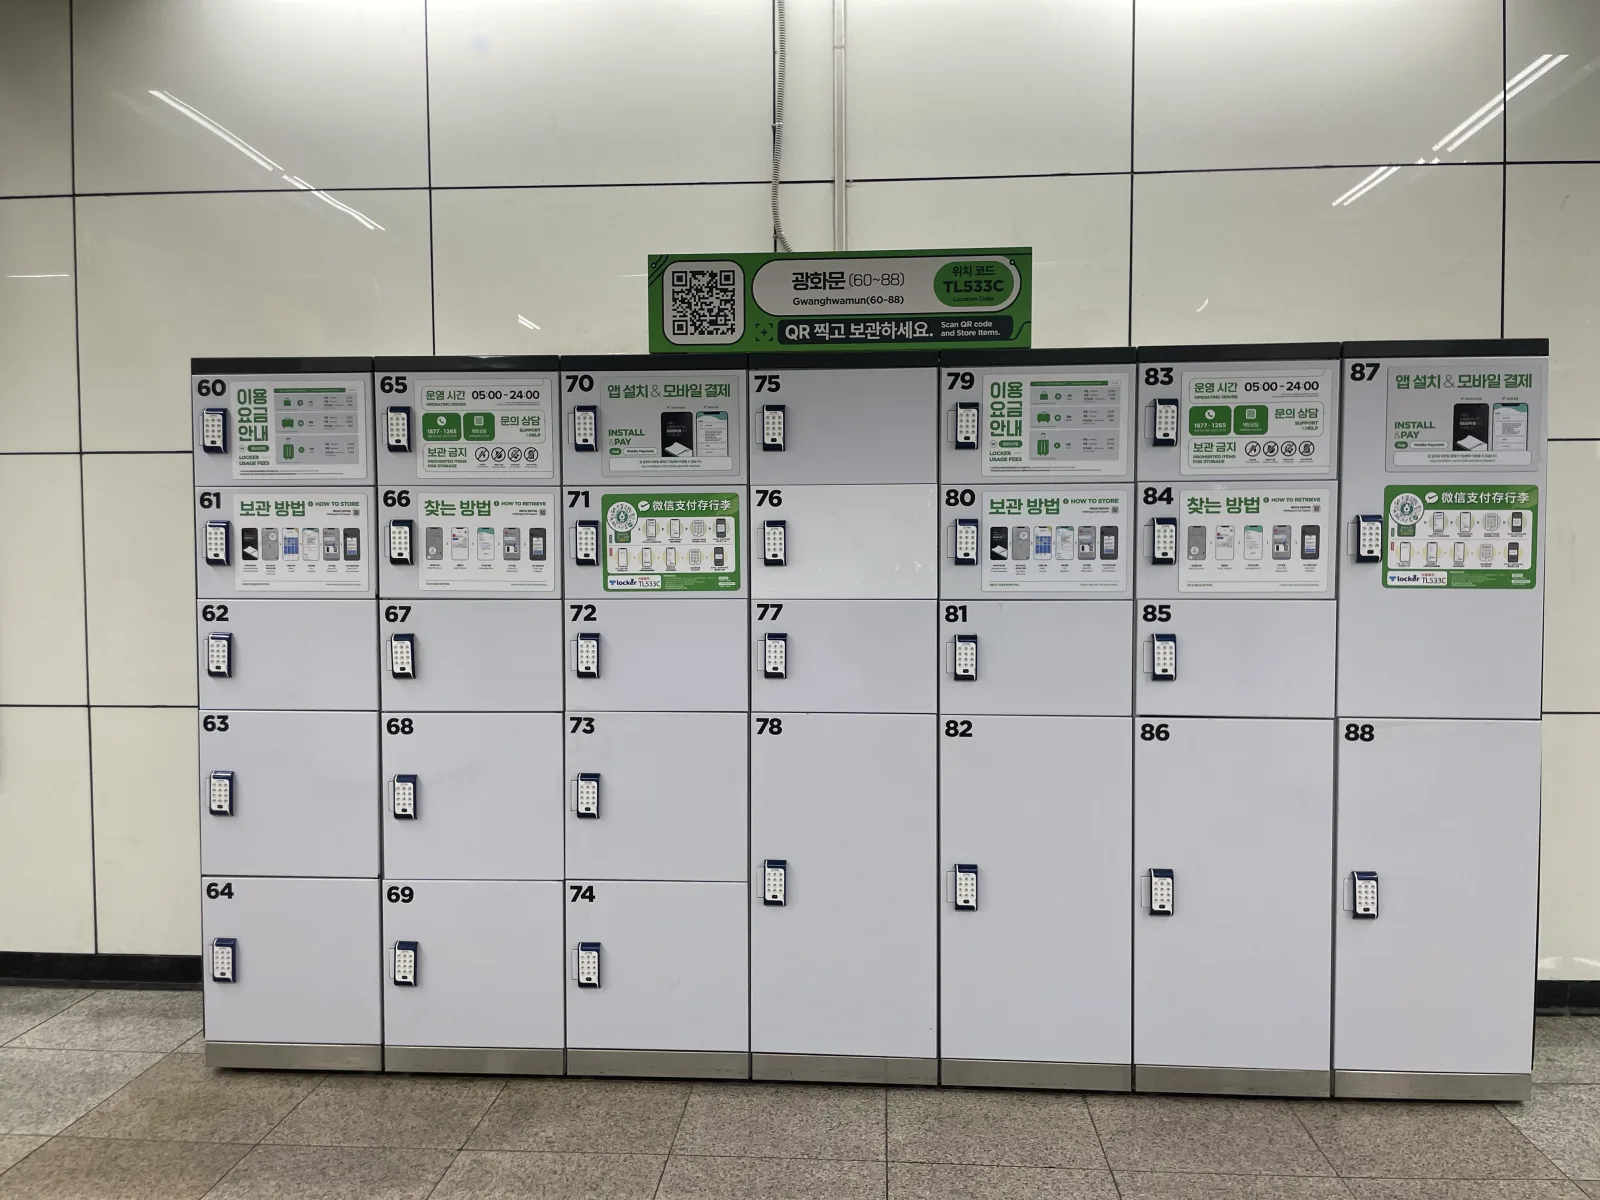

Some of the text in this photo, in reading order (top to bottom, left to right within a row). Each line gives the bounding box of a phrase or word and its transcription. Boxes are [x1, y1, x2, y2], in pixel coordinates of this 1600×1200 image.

[953, 266, 995, 277] 위치 코드
[943, 280, 1004, 292] TL533C
[793, 295, 905, 306] Gwanghwamun(60-88)
[785, 320, 933, 340] QR 찍고 보관하세요.
[1145, 367, 1173, 385] 83
[1351, 363, 1380, 381] 87
[198, 379, 226, 396] 60
[380, 376, 407, 393] 65
[566, 375, 594, 392] 70
[754, 375, 780, 392] 75
[947, 372, 974, 390] 79
[1194, 382, 1238, 393] 운영 시간
[1396, 375, 1409, 389] 앱
[1504, 374, 1532, 388] 결제
[237, 388, 267, 404] 이용
[426, 391, 466, 400] 운영 시간
[608, 385, 620, 398] 앱
[705, 384, 730, 397] 결제
[991, 382, 1022, 398] 이용
[238, 407, 268, 423] 요금
[990, 401, 1022, 417] 요금
[1275, 408, 1318, 419] 문의 상담
[500, 416, 540, 426] 문의 상담
[990, 420, 1022, 437] 안내
[239, 426, 268, 441] 안내
[428, 448, 467, 457] 보관 금지
[1193, 442, 1236, 452] 보관 금지
[200, 492, 220, 508] 61
[383, 490, 410, 507] 66
[568, 491, 589, 507] 71
[756, 490, 782, 507] 76
[946, 489, 975, 506] 80
[1143, 487, 1173, 504] 84
[1441, 492, 1529, 503] 微信支付存行李
[240, 501, 305, 516] 보관 방법
[424, 500, 491, 516] 찾는 방법
[653, 500, 731, 511] 微信支付存行李
[989, 498, 1060, 515] 보관 방법
[1187, 497, 1260, 514] 찾는 방법
[203, 605, 228, 621] 62
[385, 606, 411, 622] 67
[571, 605, 596, 621] 72
[757, 604, 783, 620] 77
[945, 606, 967, 622] 81
[1143, 605, 1171, 622] 85
[204, 715, 229, 731] 63
[387, 718, 413, 734] 68
[570, 717, 594, 734] 73
[757, 718, 782, 735] 78
[945, 720, 972, 737] 82
[1141, 724, 1169, 741] 86
[1345, 724, 1374, 741] 88
[207, 883, 234, 899] 64
[387, 886, 413, 903] 69
[570, 886, 595, 902] 74
